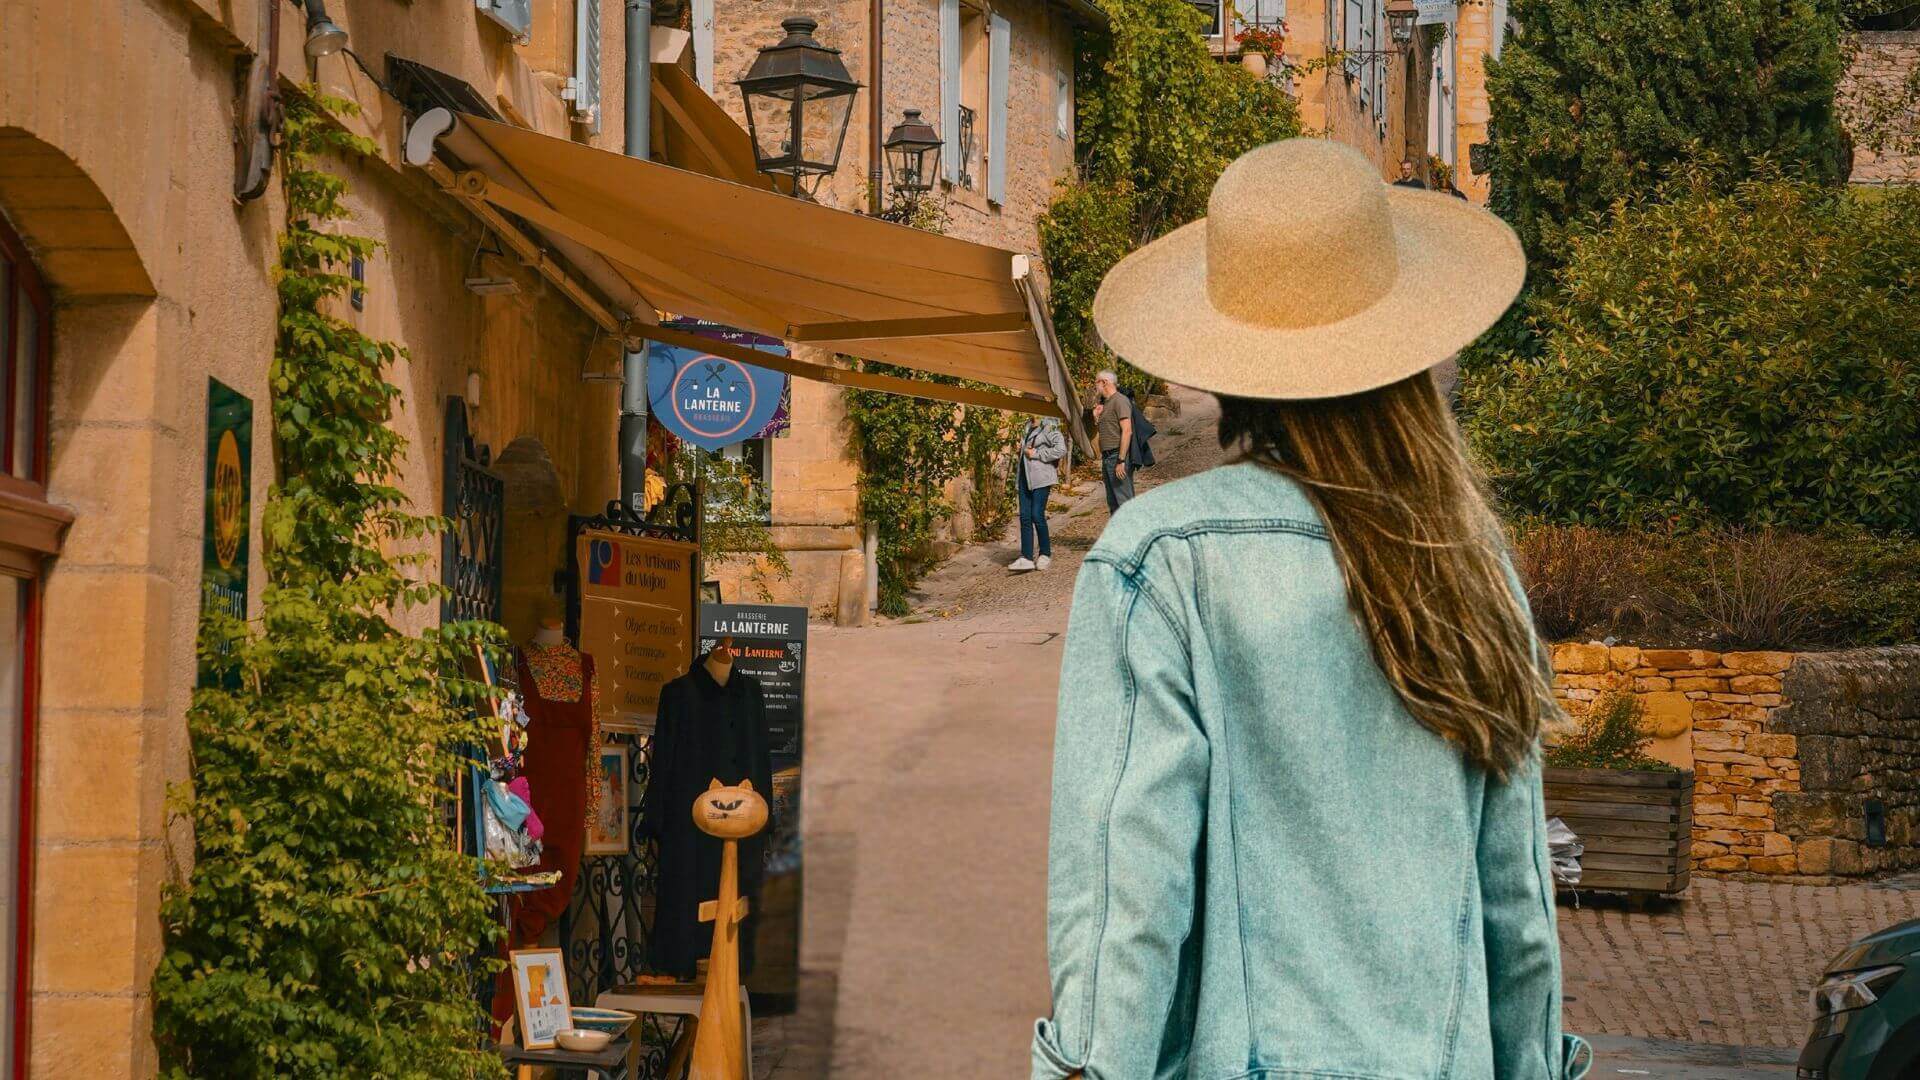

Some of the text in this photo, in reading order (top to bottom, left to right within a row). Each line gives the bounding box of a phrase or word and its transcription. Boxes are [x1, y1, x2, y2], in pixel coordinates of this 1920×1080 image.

[706, 387, 720, 399] LA
[684, 399, 741, 413] LANTERNE
[625, 549, 681, 573] Les Artisans
[737, 612, 767, 621] BRASSERIE
[714, 620, 789, 635] LA LANTERNE
